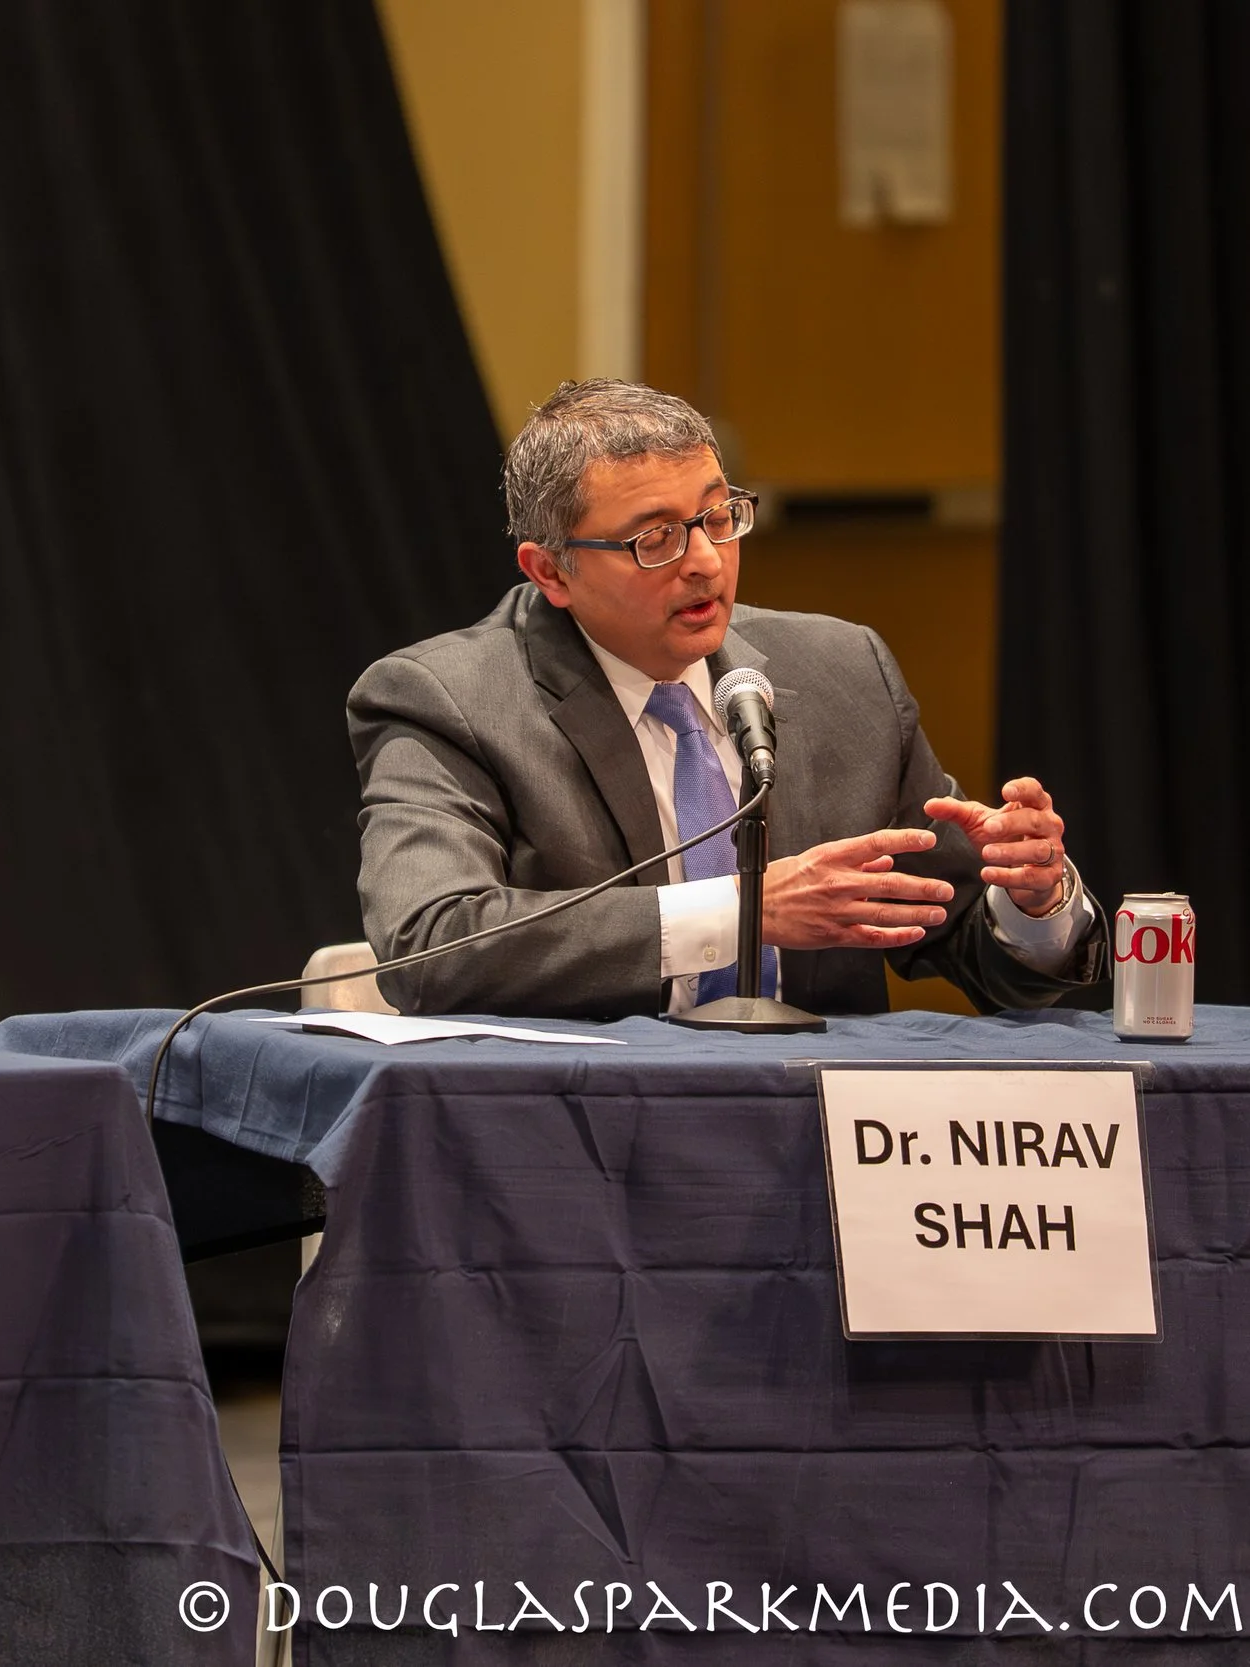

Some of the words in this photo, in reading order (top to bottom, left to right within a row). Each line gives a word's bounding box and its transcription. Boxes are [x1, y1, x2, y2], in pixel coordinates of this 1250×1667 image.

[1114, 910, 1196, 964] Cok
[853, 1119, 932, 1166] Dr.
[948, 1120, 1120, 1169] NIRAV
[914, 1202, 1076, 1252] SHAH
